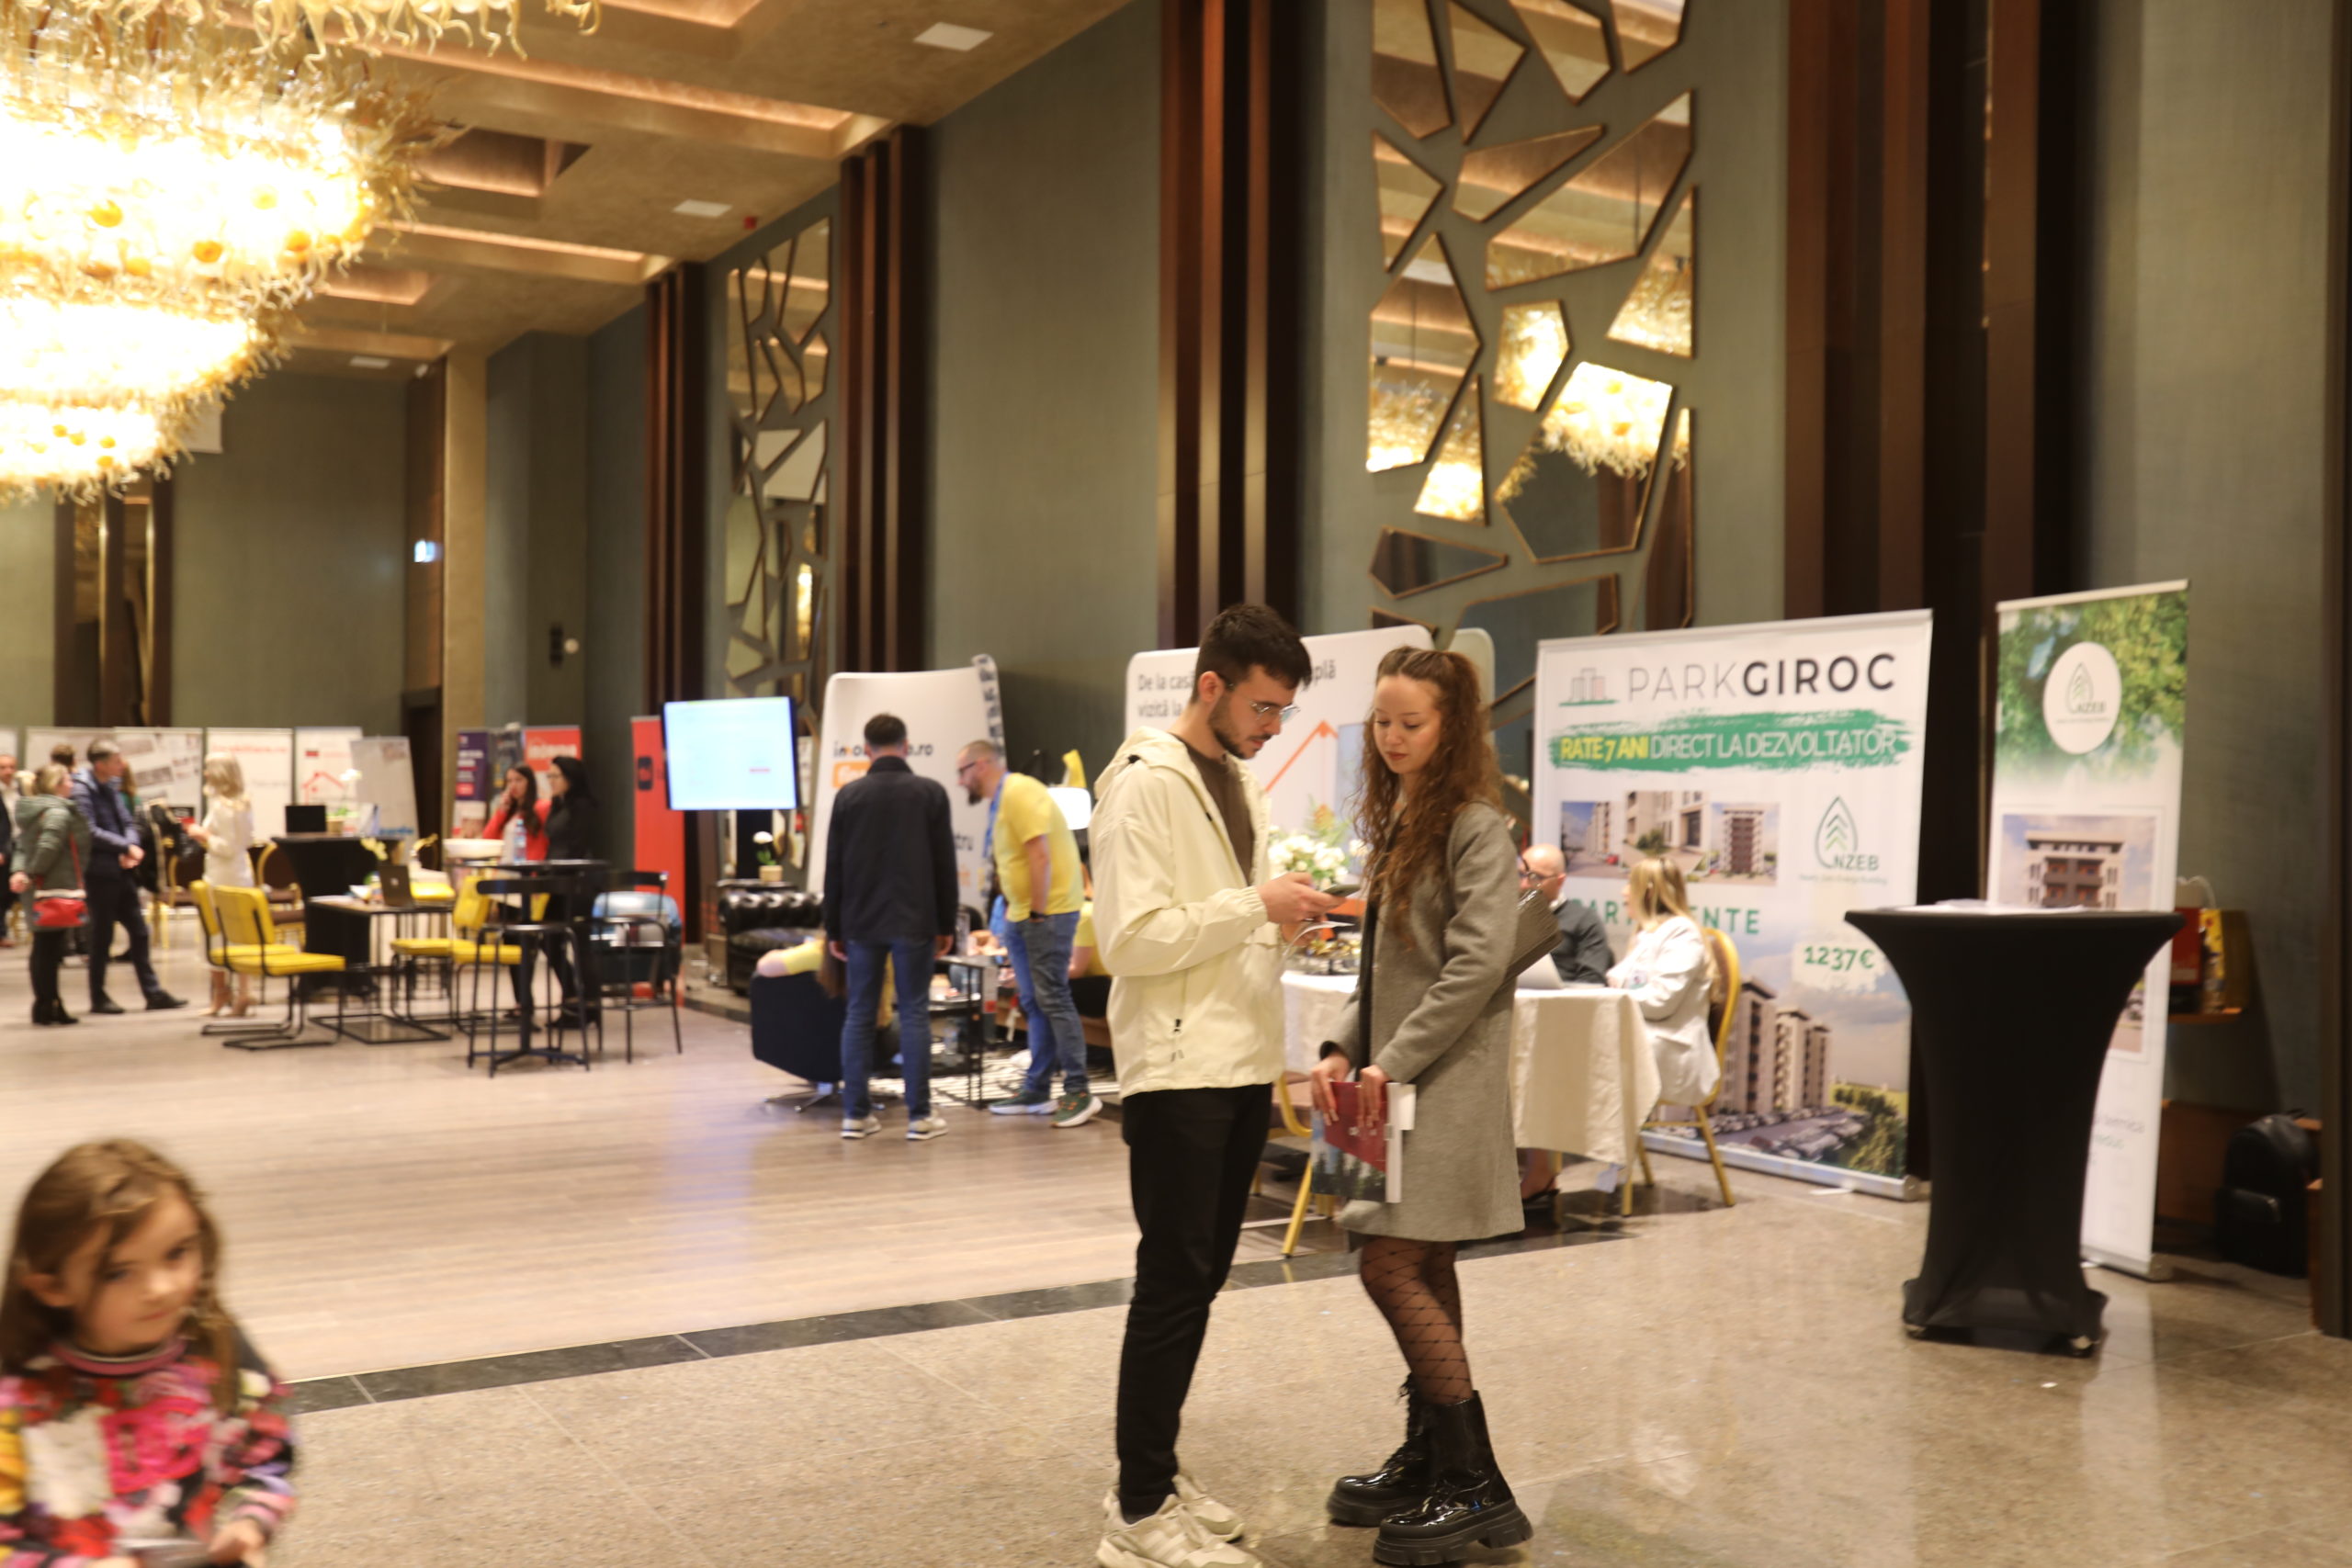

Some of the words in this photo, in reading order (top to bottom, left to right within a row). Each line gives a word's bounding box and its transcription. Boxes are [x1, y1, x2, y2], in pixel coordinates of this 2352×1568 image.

[1560, 738, 1603, 760] RATE
[1604, 739, 1617, 762] 7
[1617, 736, 1649, 760] ANI
[1650, 733, 1716, 760] DIRECT
[1717, 733, 1743, 759] LA
[1746, 728, 1897, 758] DEZVOLTATOR
[1833, 853, 1880, 871] NZEB
[1804, 946, 1875, 971] 1237€
